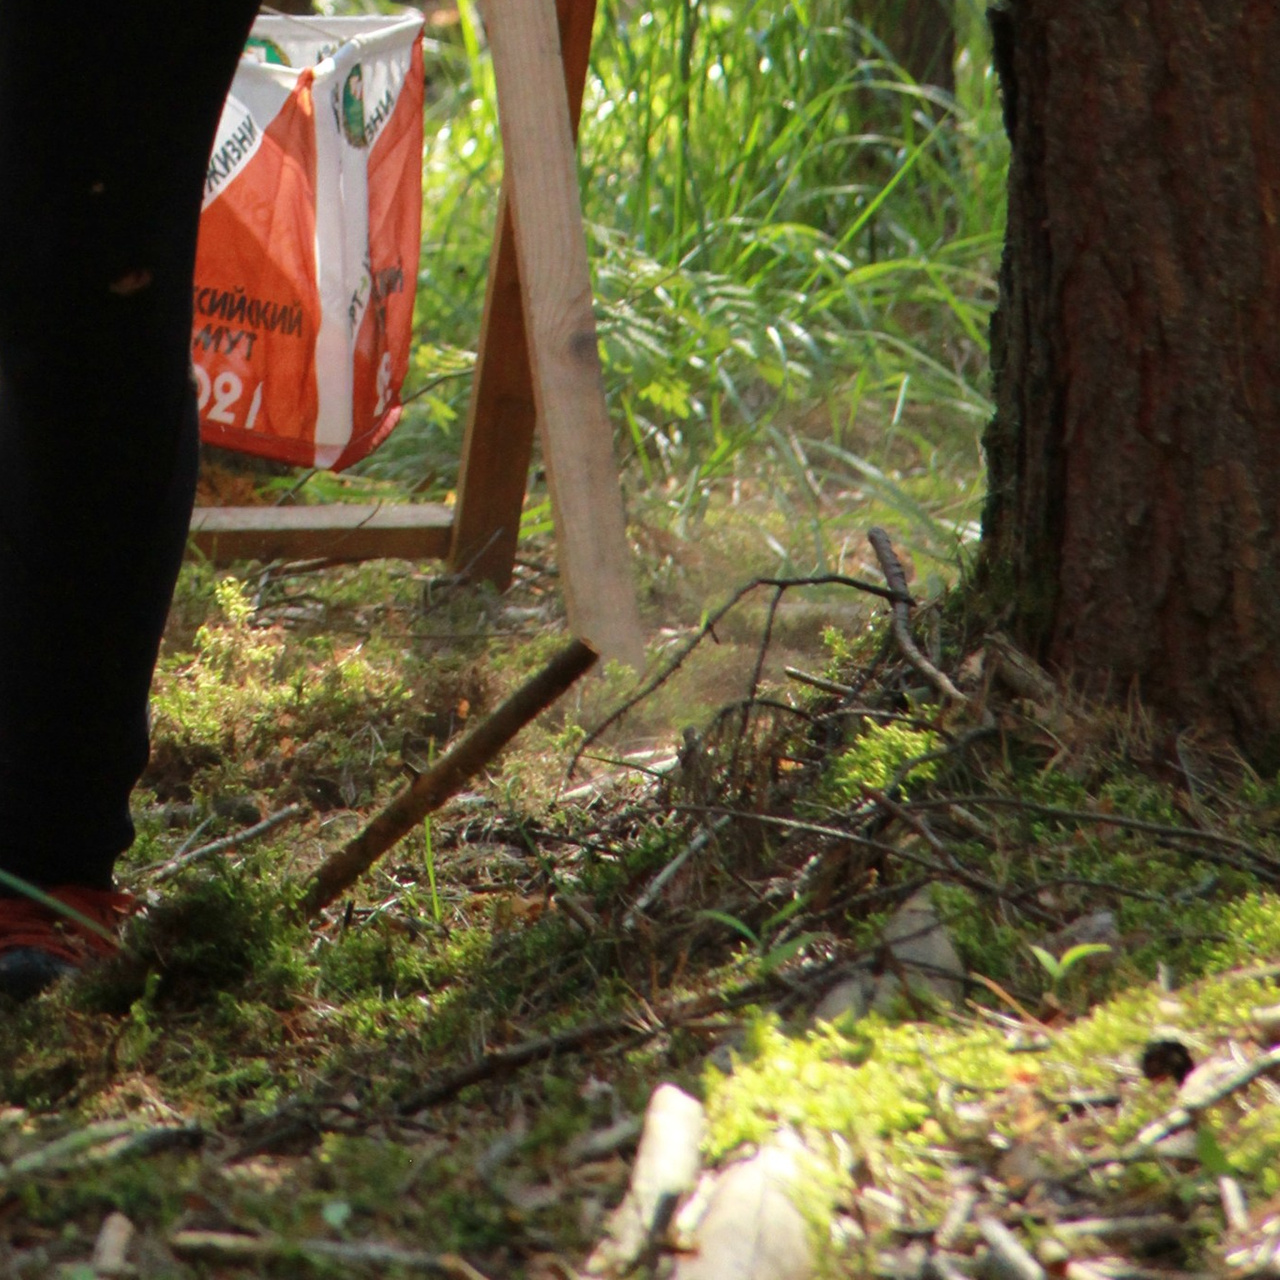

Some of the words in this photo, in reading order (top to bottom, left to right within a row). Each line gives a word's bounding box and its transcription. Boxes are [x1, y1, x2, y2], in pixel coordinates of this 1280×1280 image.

[195, 285, 302, 338] СИЙСКИЙ
[193, 323, 257, 361] МУТ
[193, 364, 263, 430] 021
